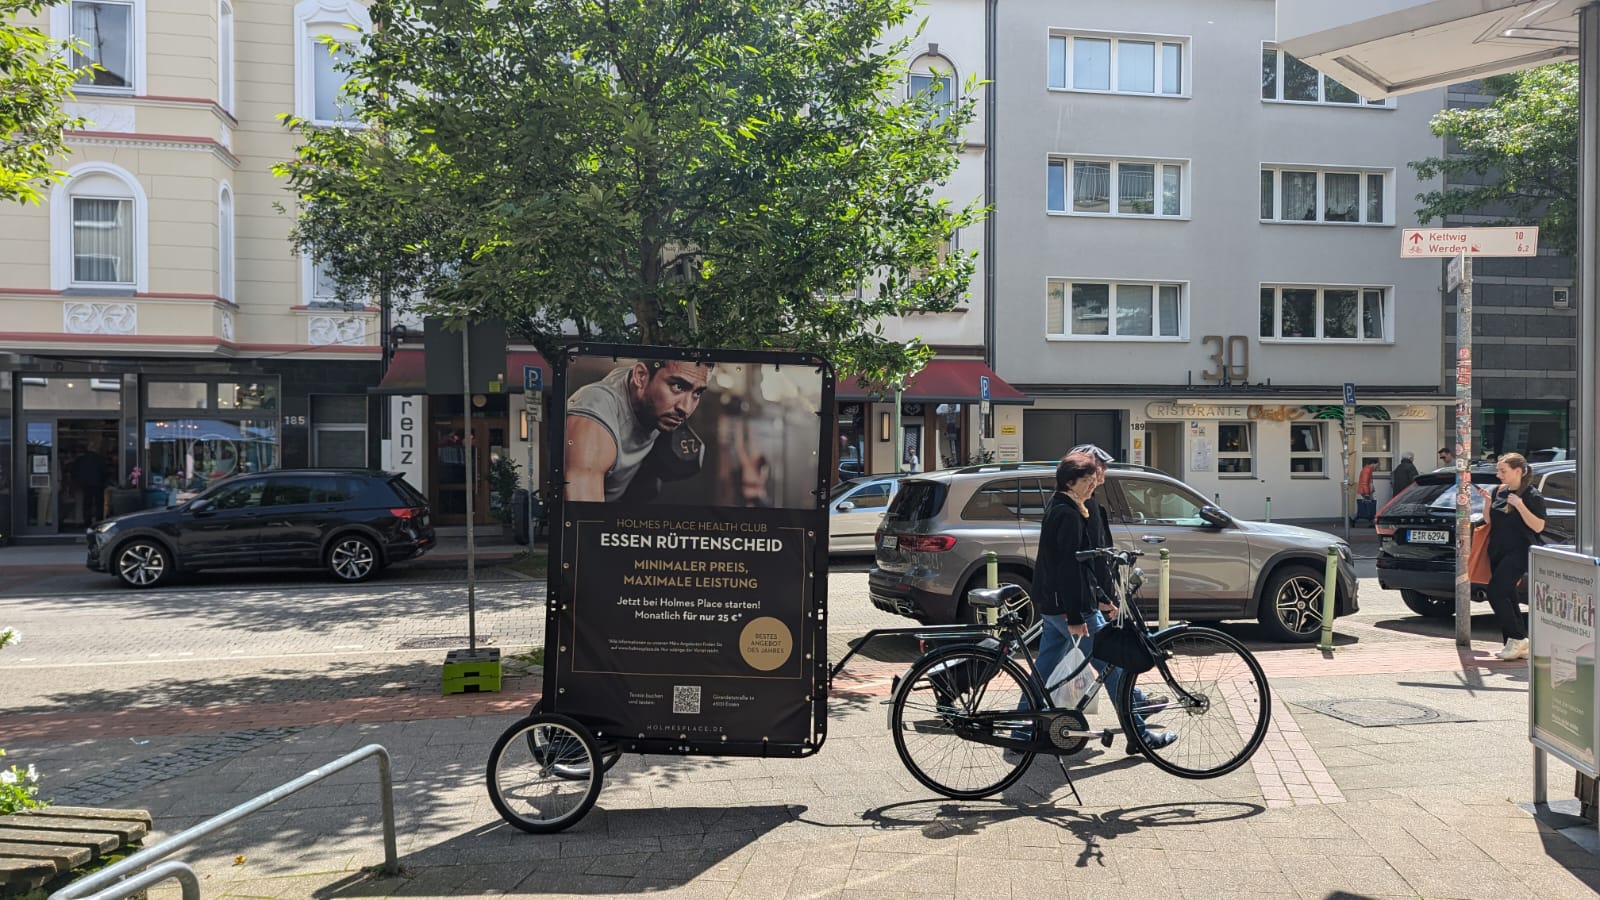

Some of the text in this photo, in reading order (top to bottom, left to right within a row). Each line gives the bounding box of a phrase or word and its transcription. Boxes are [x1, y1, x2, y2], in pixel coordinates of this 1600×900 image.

[1429, 231, 1524, 242] Kettwig 10
[1429, 244, 1467, 253] Werden
[1157, 404, 1241, 417] RISTORANTE
[284, 415, 305, 425] 185
[400, 395, 415, 465] renz
[1130, 423, 1145, 431] 189
[617, 519, 768, 533] HOLMES PLACE HEALTH CLUB
[600, 532, 783, 552] ESSEN RÜTTENSCHEID
[634, 559, 749, 574] MINIMALER PREIS,
[623, 575, 758, 589] MAXIMALE LEISTUNG
[617, 596, 761, 609] Jetzt bei Holmes Place starten!
[634, 610, 681, 620] Monatlich
[682, 611, 698, 621] für
[699, 613, 716, 621] nur
[717, 614, 729, 622] 25
[646, 724, 724, 732] HOLMESPLACE.DE
